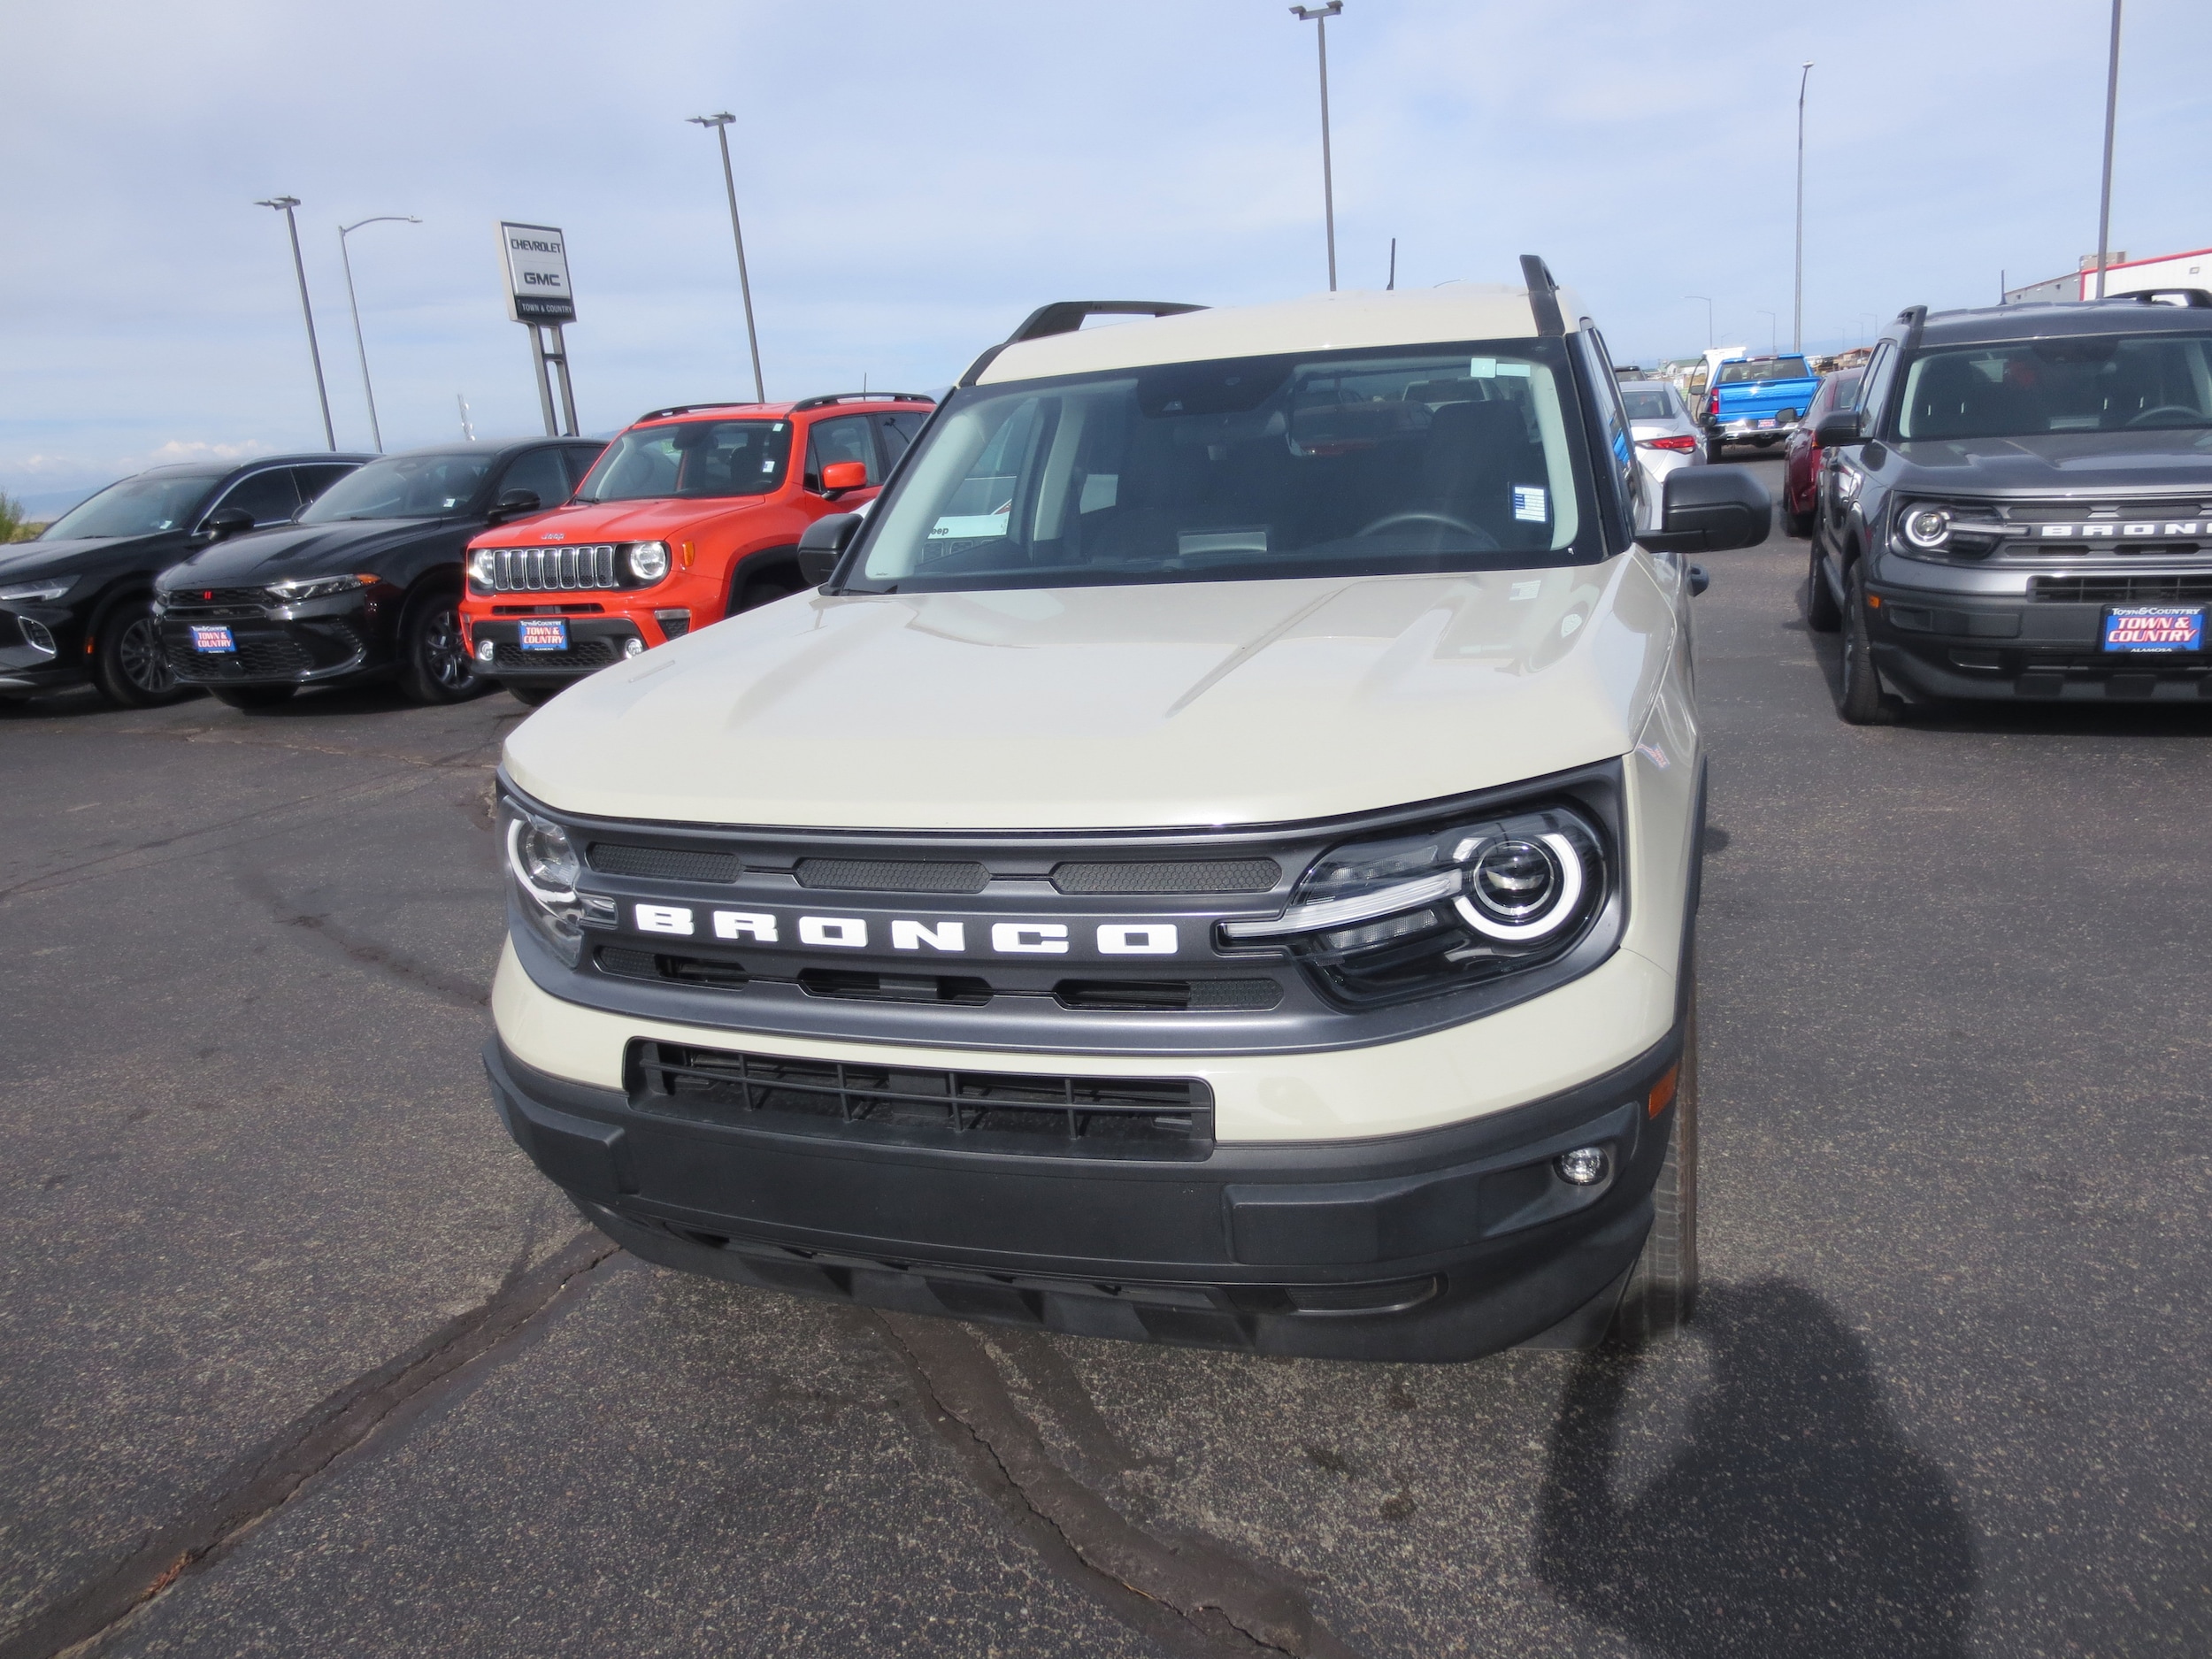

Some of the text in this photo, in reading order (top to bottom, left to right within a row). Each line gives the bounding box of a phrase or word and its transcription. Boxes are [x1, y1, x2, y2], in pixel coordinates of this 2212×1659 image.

[511, 238, 562, 253] CHEVROLET
[524, 272, 561, 287] GMC
[521, 303, 539, 312] TOWN
[546, 304, 572, 313] COUNTRY
[931, 527, 949, 536] eep
[2117, 617, 2190, 629] TOWN &
[526, 626, 560, 635] TOWN &
[2108, 629, 2198, 642] COUNTRY
[197, 639, 232, 648] COUNTRY
[524, 635, 565, 644] COUNTRY
[634, 903, 1179, 954] BRONCO
